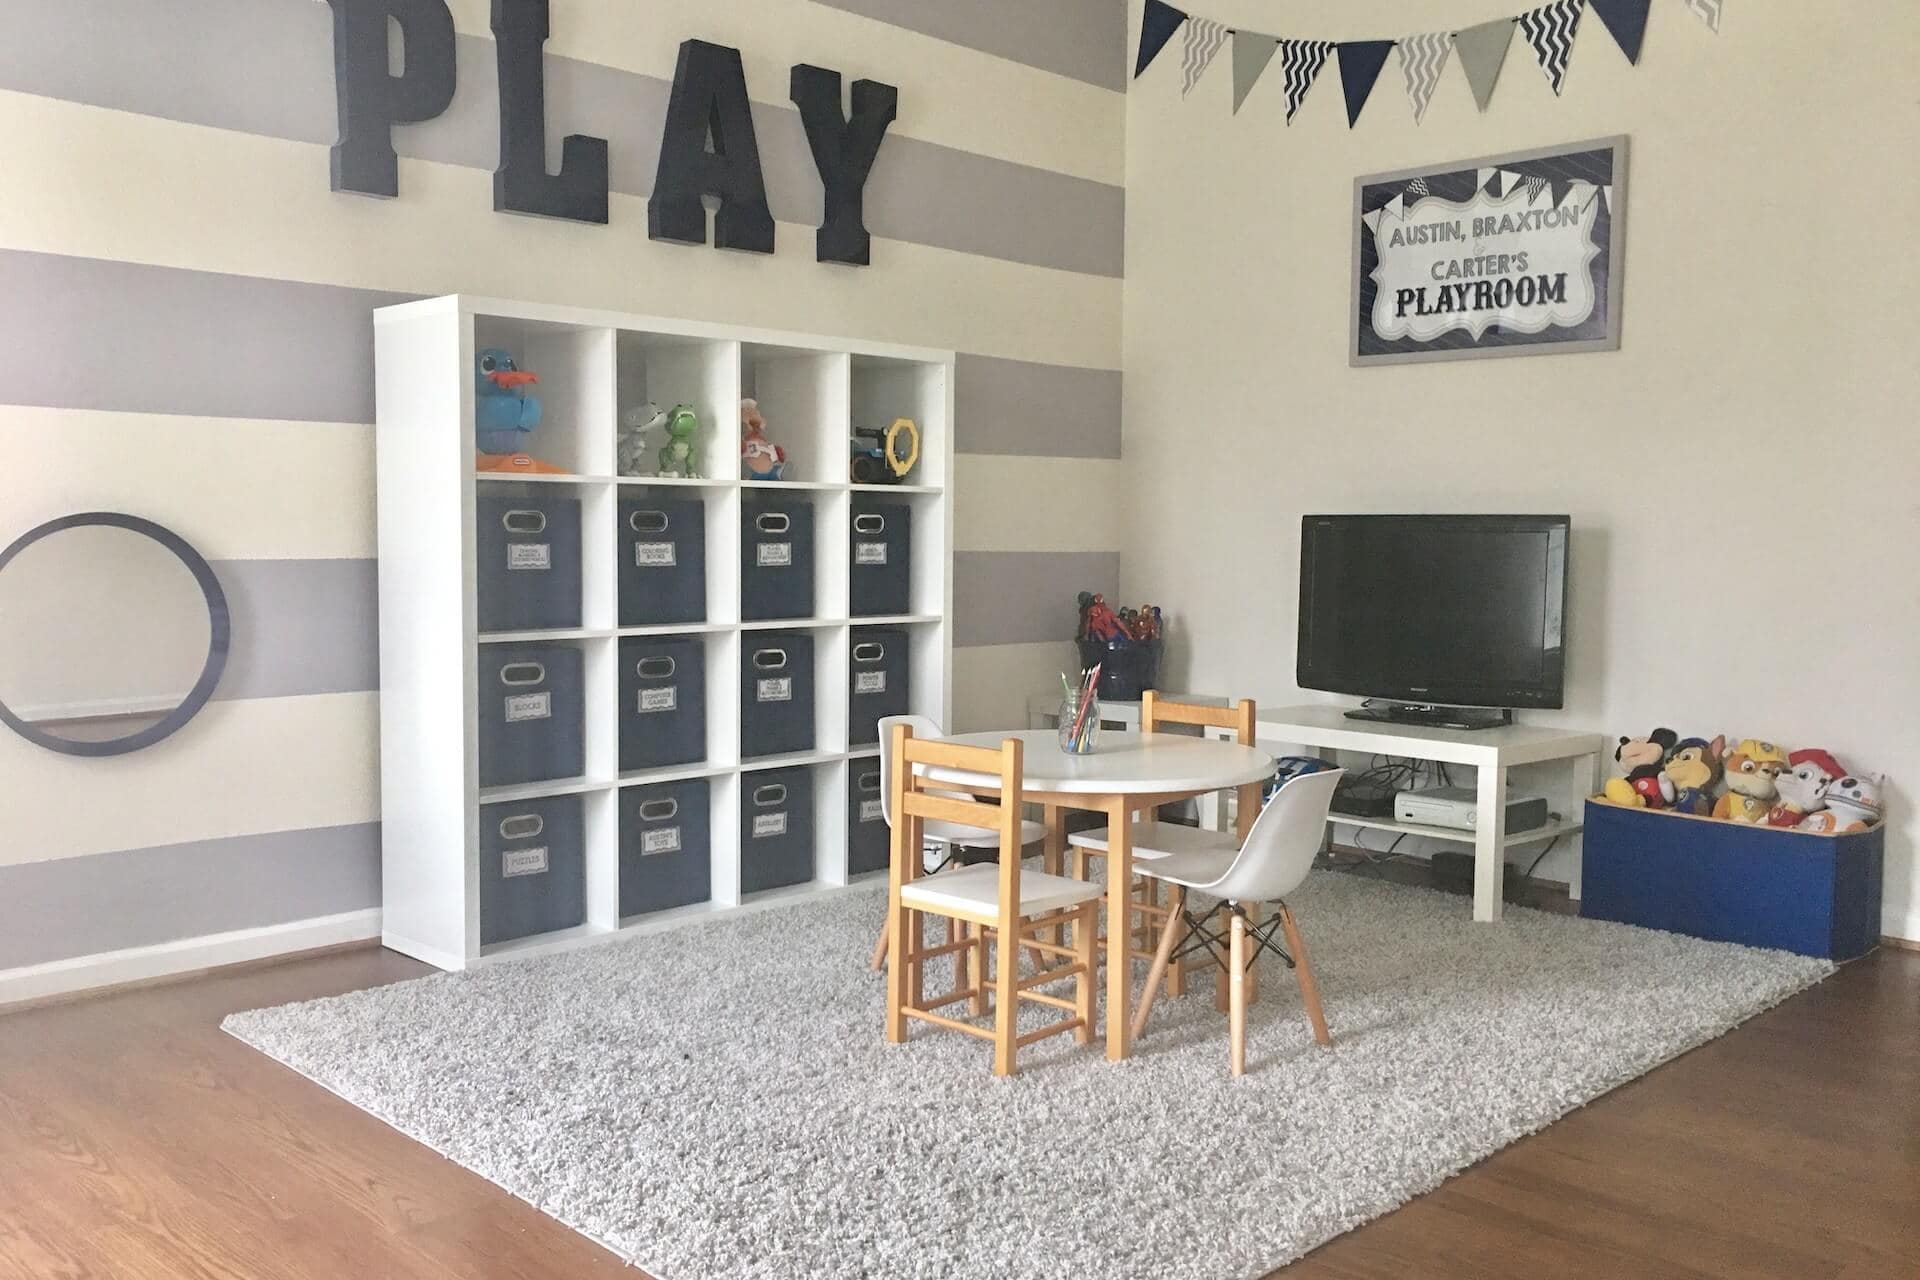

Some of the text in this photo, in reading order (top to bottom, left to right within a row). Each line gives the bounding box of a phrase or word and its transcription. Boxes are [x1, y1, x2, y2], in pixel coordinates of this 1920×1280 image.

[330, 0, 898, 266] PLAY
[1389, 205, 1580, 249] AUSTIN, BRAXTON
[1431, 251, 1529, 281] CARTER'S
[1395, 273, 1568, 318] PLAYROOM
[514, 702, 542, 712] BLOCKS
